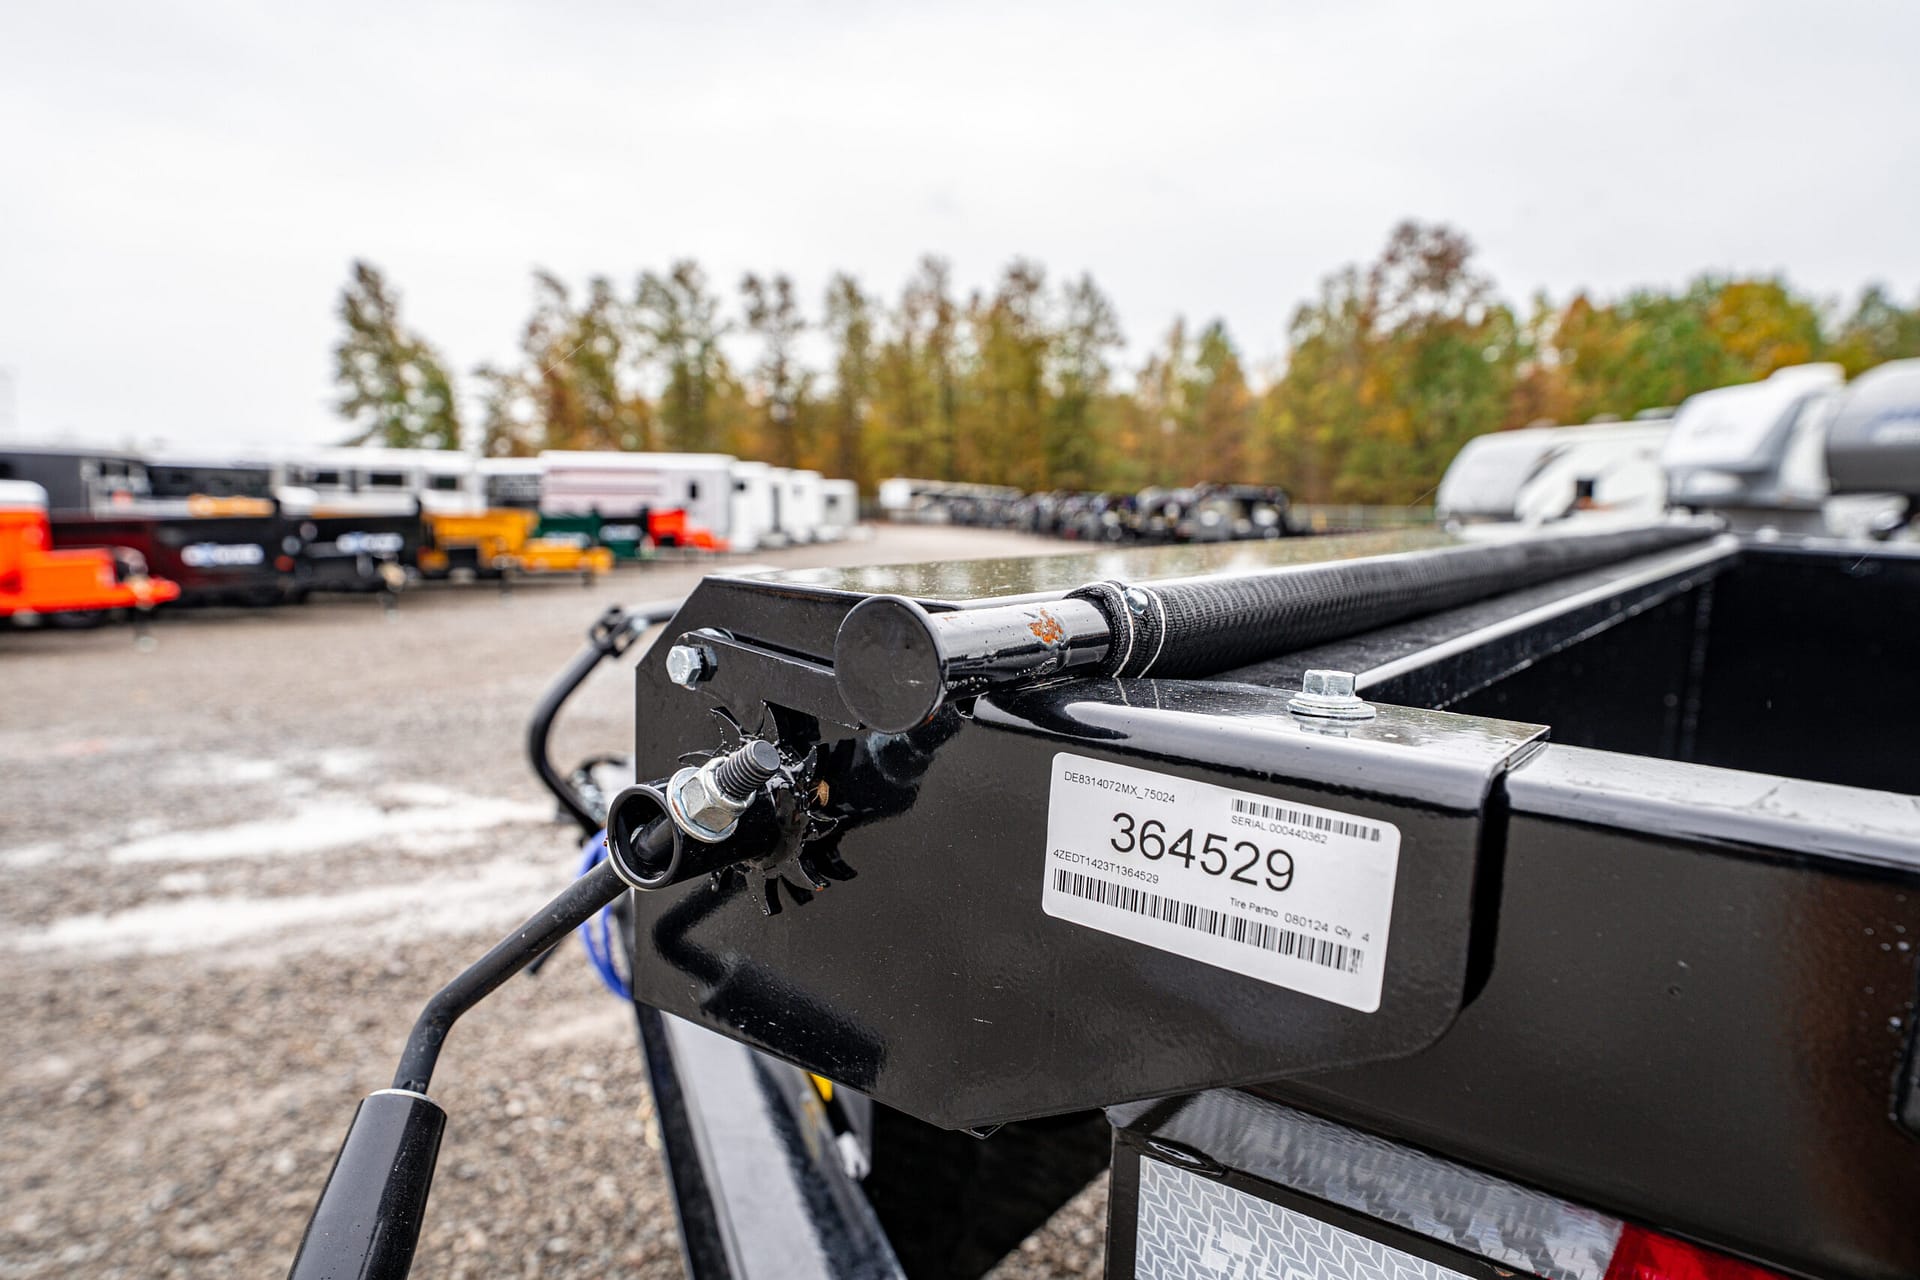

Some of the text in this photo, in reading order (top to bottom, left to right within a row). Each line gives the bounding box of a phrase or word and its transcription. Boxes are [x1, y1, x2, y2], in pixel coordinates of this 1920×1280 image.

[1064, 771, 1175, 803] DE8314072MX_75024
[1231, 815, 1328, 844] SERIAL 000440362
[1053, 849, 1160, 885] 4ZEDT1423T1364529
[1110, 812, 1295, 892] 364529
[1230, 897, 1247, 910] Tire
[1284, 912, 1328, 933] 080124
[1361, 932, 1370, 942] 4
